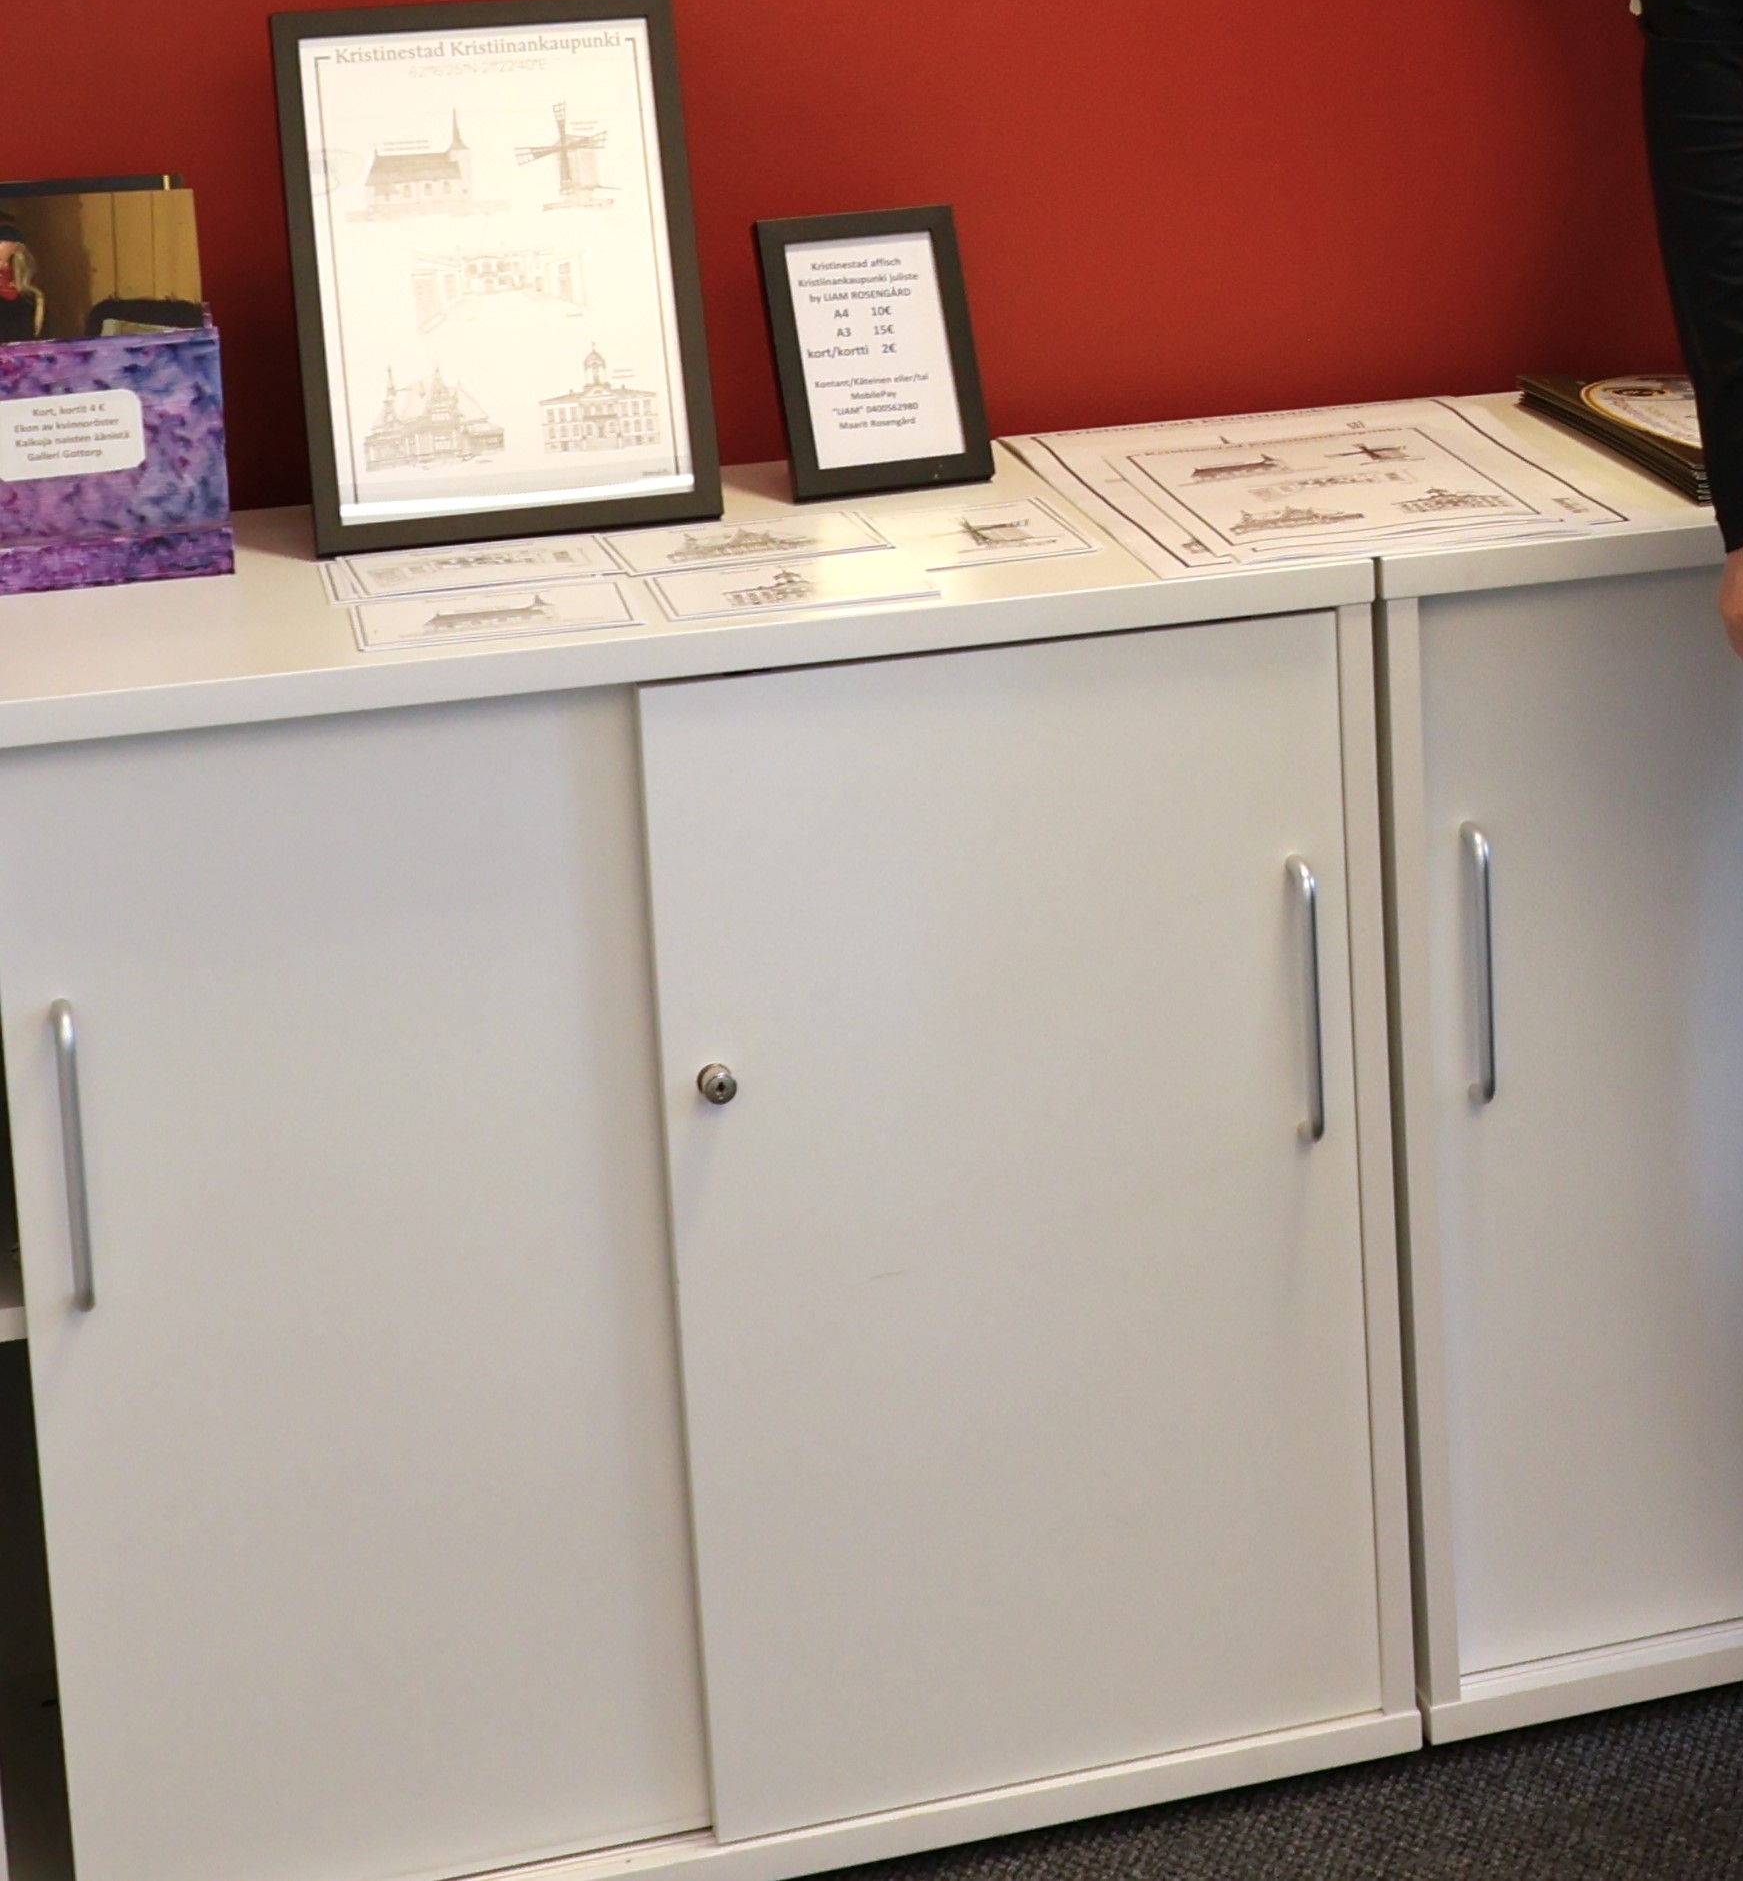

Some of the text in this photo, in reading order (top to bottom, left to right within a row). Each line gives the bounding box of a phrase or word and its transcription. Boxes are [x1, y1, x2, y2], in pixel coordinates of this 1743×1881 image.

[335, 32, 622, 64] Kristinestad Kristiinankaupunki
[811, 258, 902, 271] Kristinestad affisch
[798, 273, 918, 287] Kristiinankaupunki juliste
[809, 294, 821, 304] by
[851, 287, 911, 300] ROSENGÅRD
[833, 305, 892, 319] A4 10€
[836, 324, 895, 337] A3 15€
[807, 343, 897, 359] kort/kortti 2€
[850, 390, 897, 400] MobilePay
[839, 416, 917, 430] Maarit Rosengård
